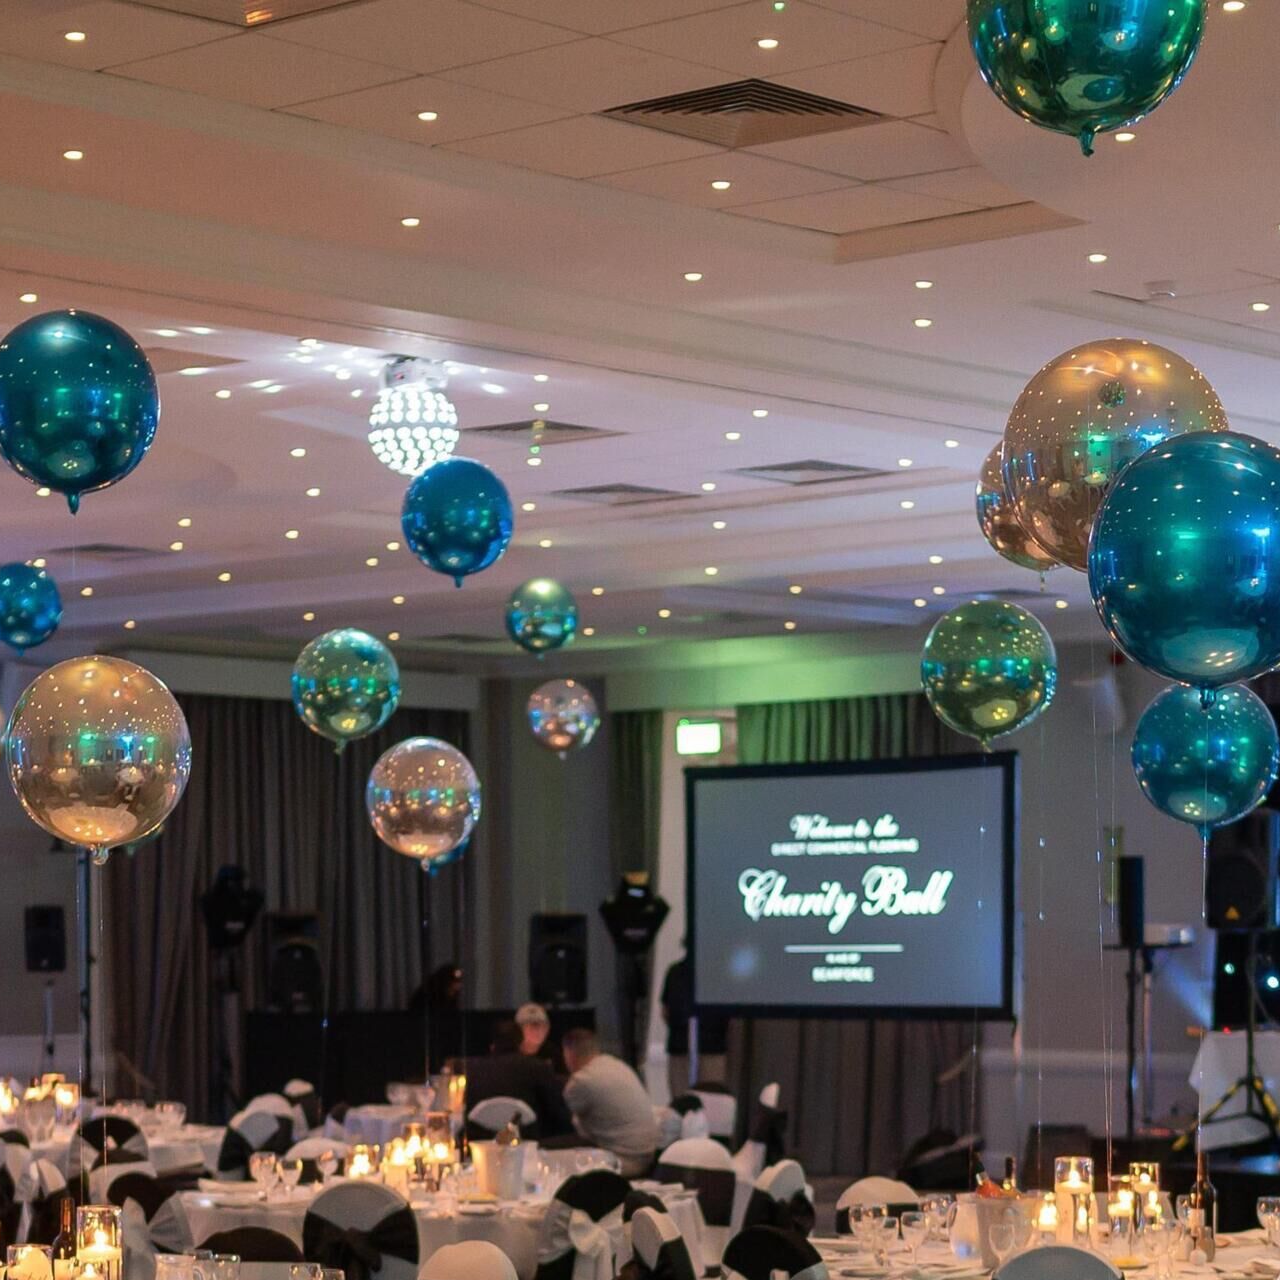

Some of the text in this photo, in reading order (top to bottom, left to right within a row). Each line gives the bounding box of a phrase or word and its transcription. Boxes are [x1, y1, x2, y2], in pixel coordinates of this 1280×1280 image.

[789, 814, 900, 840] Welcome to the
[738, 865, 953, 935] Charity Ball
